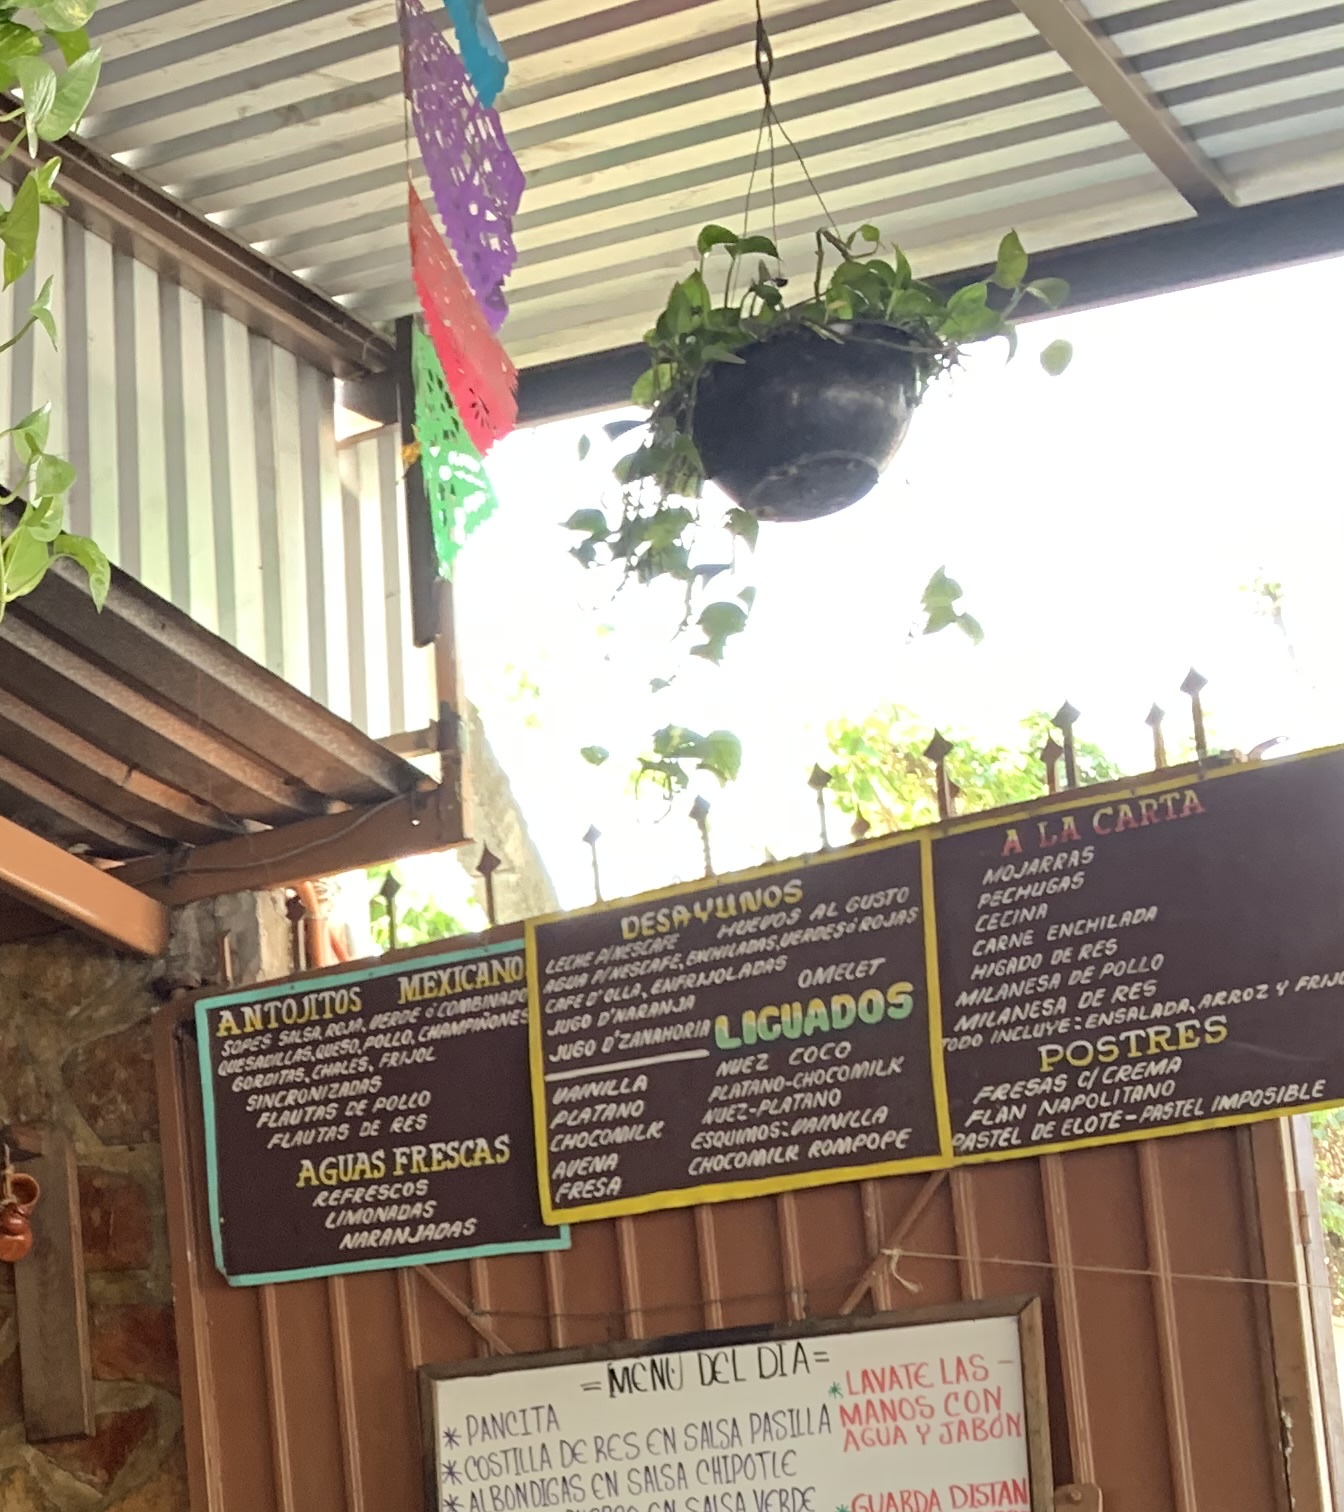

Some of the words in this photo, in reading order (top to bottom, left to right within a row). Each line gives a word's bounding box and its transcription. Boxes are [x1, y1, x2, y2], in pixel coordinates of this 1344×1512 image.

[1001, 828, 1023, 857] A
[1037, 816, 1082, 848] LA
[1092, 789, 1206, 836] CARTA
[982, 845, 1095, 886] MOJARRAS
[620, 878, 803, 940] DESAYUNOS
[977, 871, 1085, 910] PECHUGAS
[717, 907, 802, 939] HUEVOS
[809, 902, 839, 921] AL
[845, 886, 910, 913] GUSTO
[971, 929, 1035, 957] CARNE
[1046, 905, 1158, 942] ENCHILADA
[974, 903, 1049, 933] CECINA
[543, 973, 589, 994] AGUA
[859, 906, 920, 932] ROJAS
[545, 951, 595, 974] LECHE
[970, 953, 1043, 980] HIGADO
[1050, 948, 1072, 966] DE
[1078, 938, 1118, 962] RES
[650, 954, 789, 996] ENFRIJOLADAS
[798, 957, 886, 989] OMELET
[955, 973, 1062, 1008] MILANESA
[1068, 965, 1096, 986] DE
[1099, 953, 1165, 980] POLLO
[216, 987, 362, 1037] ANTOJITOS
[397, 956, 524, 1004] MEXICANO
[942, 1033, 984, 1052] TODO
[1197, 984, 1269, 1010] ARROZ
[1276, 979, 1289, 997] Y
[953, 996, 1067, 1032] MILANESA
[1078, 988, 1106, 1009] DE
[1111, 979, 1158, 1004] RES
[221, 1033, 272, 1057] SOPES
[369, 1007, 421, 1029] VERDE
[547, 1013, 592, 1036] JUGO
[1037, 1014, 1229, 1073] POSTRES
[379, 1046, 436, 1067] FRIJOL
[548, 1039, 597, 1062] JUGO
[716, 1053, 769, 1077] NUEZ
[788, 1041, 852, 1066] COCO
[246, 1075, 382, 1112] SINCRONIZADAS
[552, 1074, 649, 1105] VAINILLA
[965, 1103, 1027, 1128] FLAN
[1037, 1079, 1176, 1117] NAPOLITANO
[973, 1073, 1068, 1105] FRESAS
[256, 1103, 339, 1128] FLAUTAS
[345, 1099, 369, 1116] DE
[372, 1090, 431, 1113] POLLO
[549, 1100, 645, 1129] PLATANO
[791, 1105, 889, 1136] VAINILLA
[951, 1126, 1022, 1151] PASTEL
[1031, 1121, 1056, 1141] DE
[1211, 1079, 1327, 1113] IMPOSIBLE
[267, 1123, 350, 1149] FLAUTAS
[359, 1120, 380, 1136] DE
[390, 1114, 428, 1133] RES
[549, 1121, 665, 1153] CHOCOMILK
[295, 1150, 386, 1188] AGUAS
[392, 1134, 511, 1176] FRESCAS
[552, 1152, 619, 1180] AVENA
[688, 1145, 799, 1176] CHOCOMILK
[808, 1127, 912, 1159] ROMPOPE
[312, 1179, 429, 1207] REFRESCOS
[555, 1176, 622, 1203] FRESA
[325, 1200, 437, 1229] LIMONADAS
[339, 1218, 477, 1250] NARANJADAS
[697, 1348, 746, 1387] DEL
[845, 1362, 934, 1396] LAVATE
[940, 1354, 989, 1385] LAS
[465, 1403, 560, 1446] PANCITA
[839, 1395, 935, 1428] MANOS
[944, 1386, 1002, 1417] CON
[464, 1442, 552, 1482] COSTILLA
[559, 1439, 588, 1469] DE
[593, 1432, 640, 1463] RES
[646, 1426, 677, 1456] EN
[684, 1417, 742, 1451] SALSA
[749, 1403, 832, 1444] PASILLA
[843, 1425, 907, 1452] AGUA
[916, 1424, 931, 1445] Y
[591, 1470, 620, 1500] EN
[627, 1461, 688, 1496] SALSA
[696, 1449, 797, 1485] CHIPOTLE
[949, 1477, 1029, 1509] DISTAN
